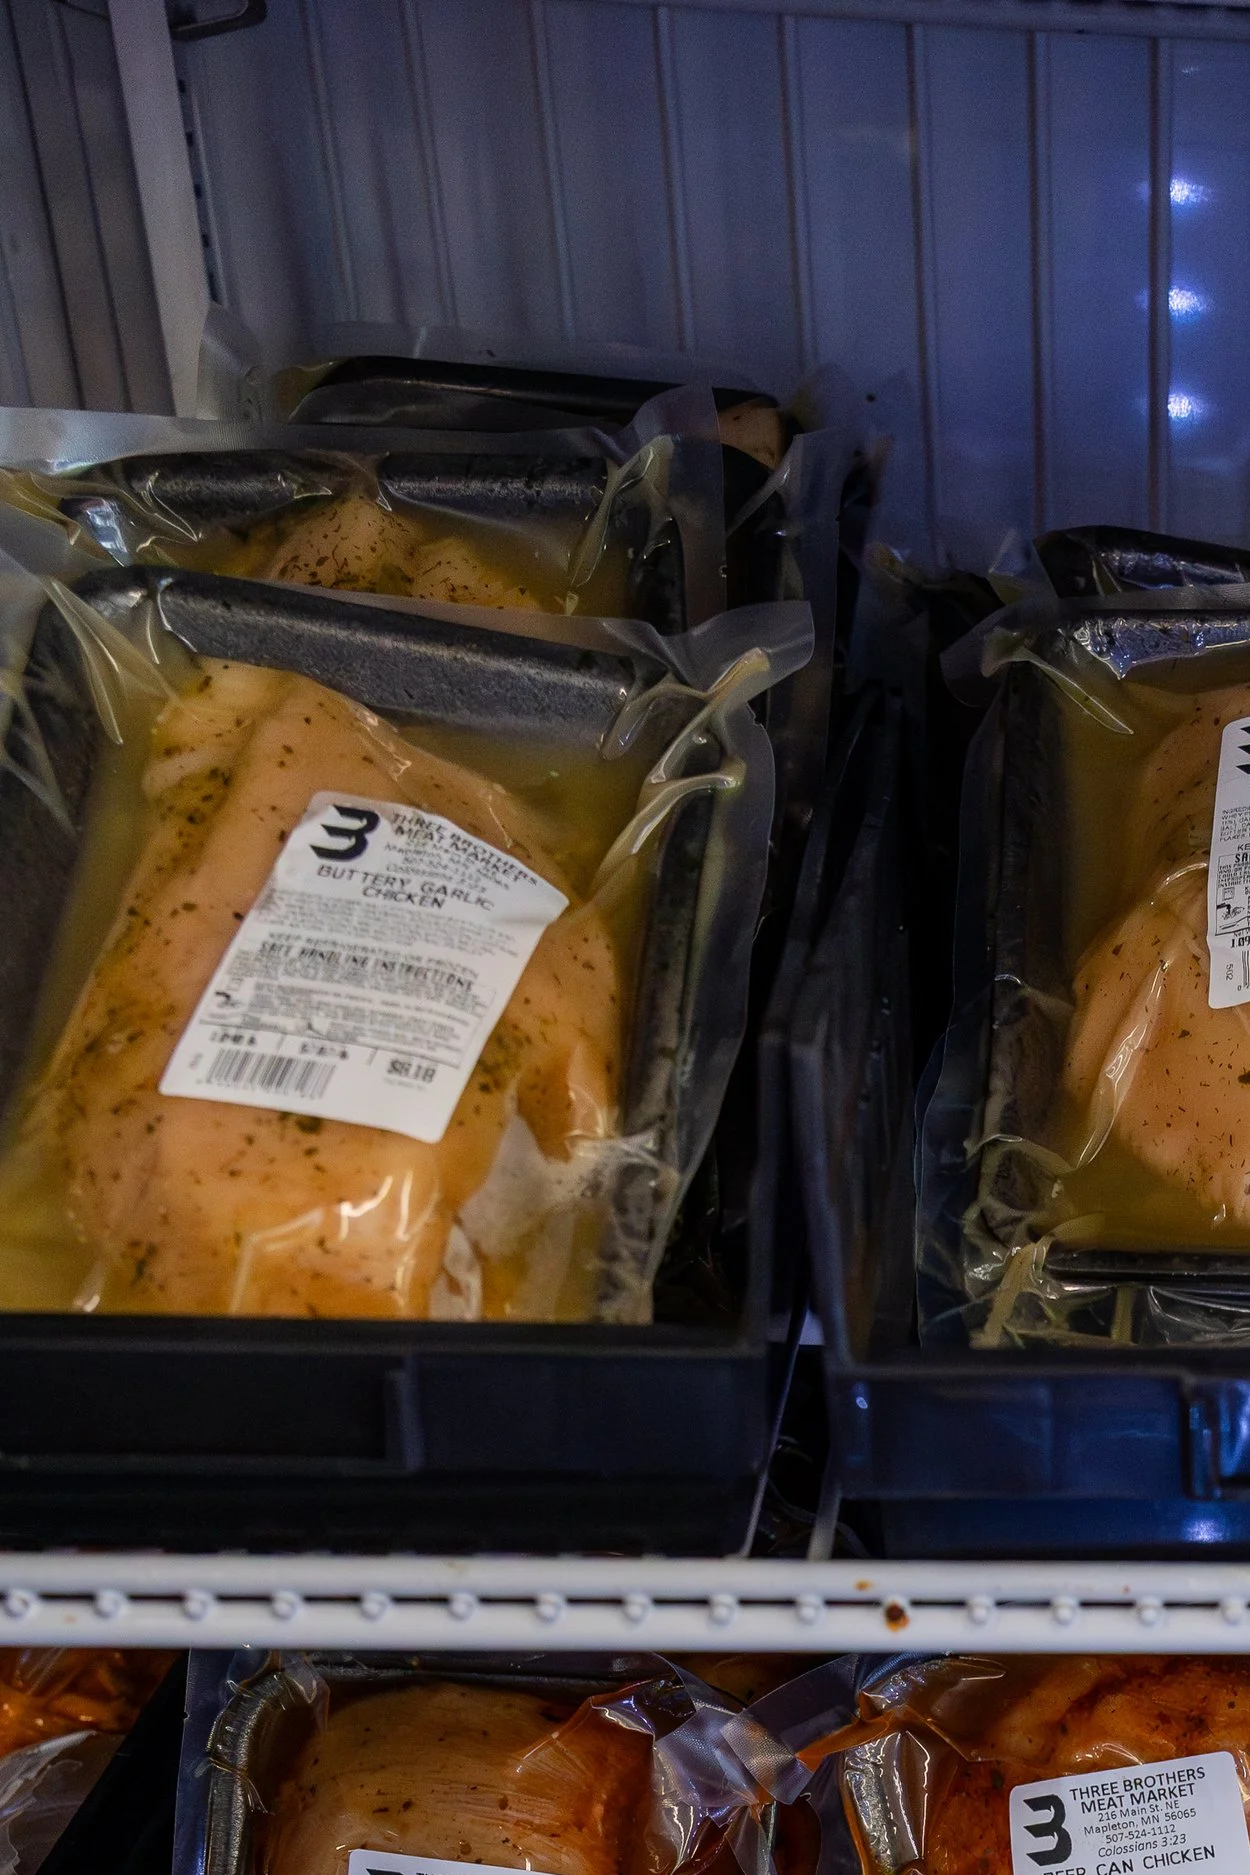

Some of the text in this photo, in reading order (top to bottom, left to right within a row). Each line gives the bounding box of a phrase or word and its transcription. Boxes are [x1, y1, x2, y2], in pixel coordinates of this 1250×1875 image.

[448, 839, 522, 883] MARKET
[449, 832, 539, 887] BROTHERS
[317, 864, 495, 911] BUTTERY GARLIC
[362, 886, 446, 910] CHICKEN
[1069, 1766, 1205, 1801] THREE BROTHERS
[1080, 1782, 1195, 1814] MEAT MARKET
[1083, 1807, 1197, 1836] Mapleton, MN 56065
[1097, 1799, 1180, 1822] 216 Main St. NE
[1097, 1833, 1186, 1858] Colossians 3:23
[1105, 1823, 1176, 1844] 507-524-1112
[1142, 1844, 1215, 1869] CHICKEN
